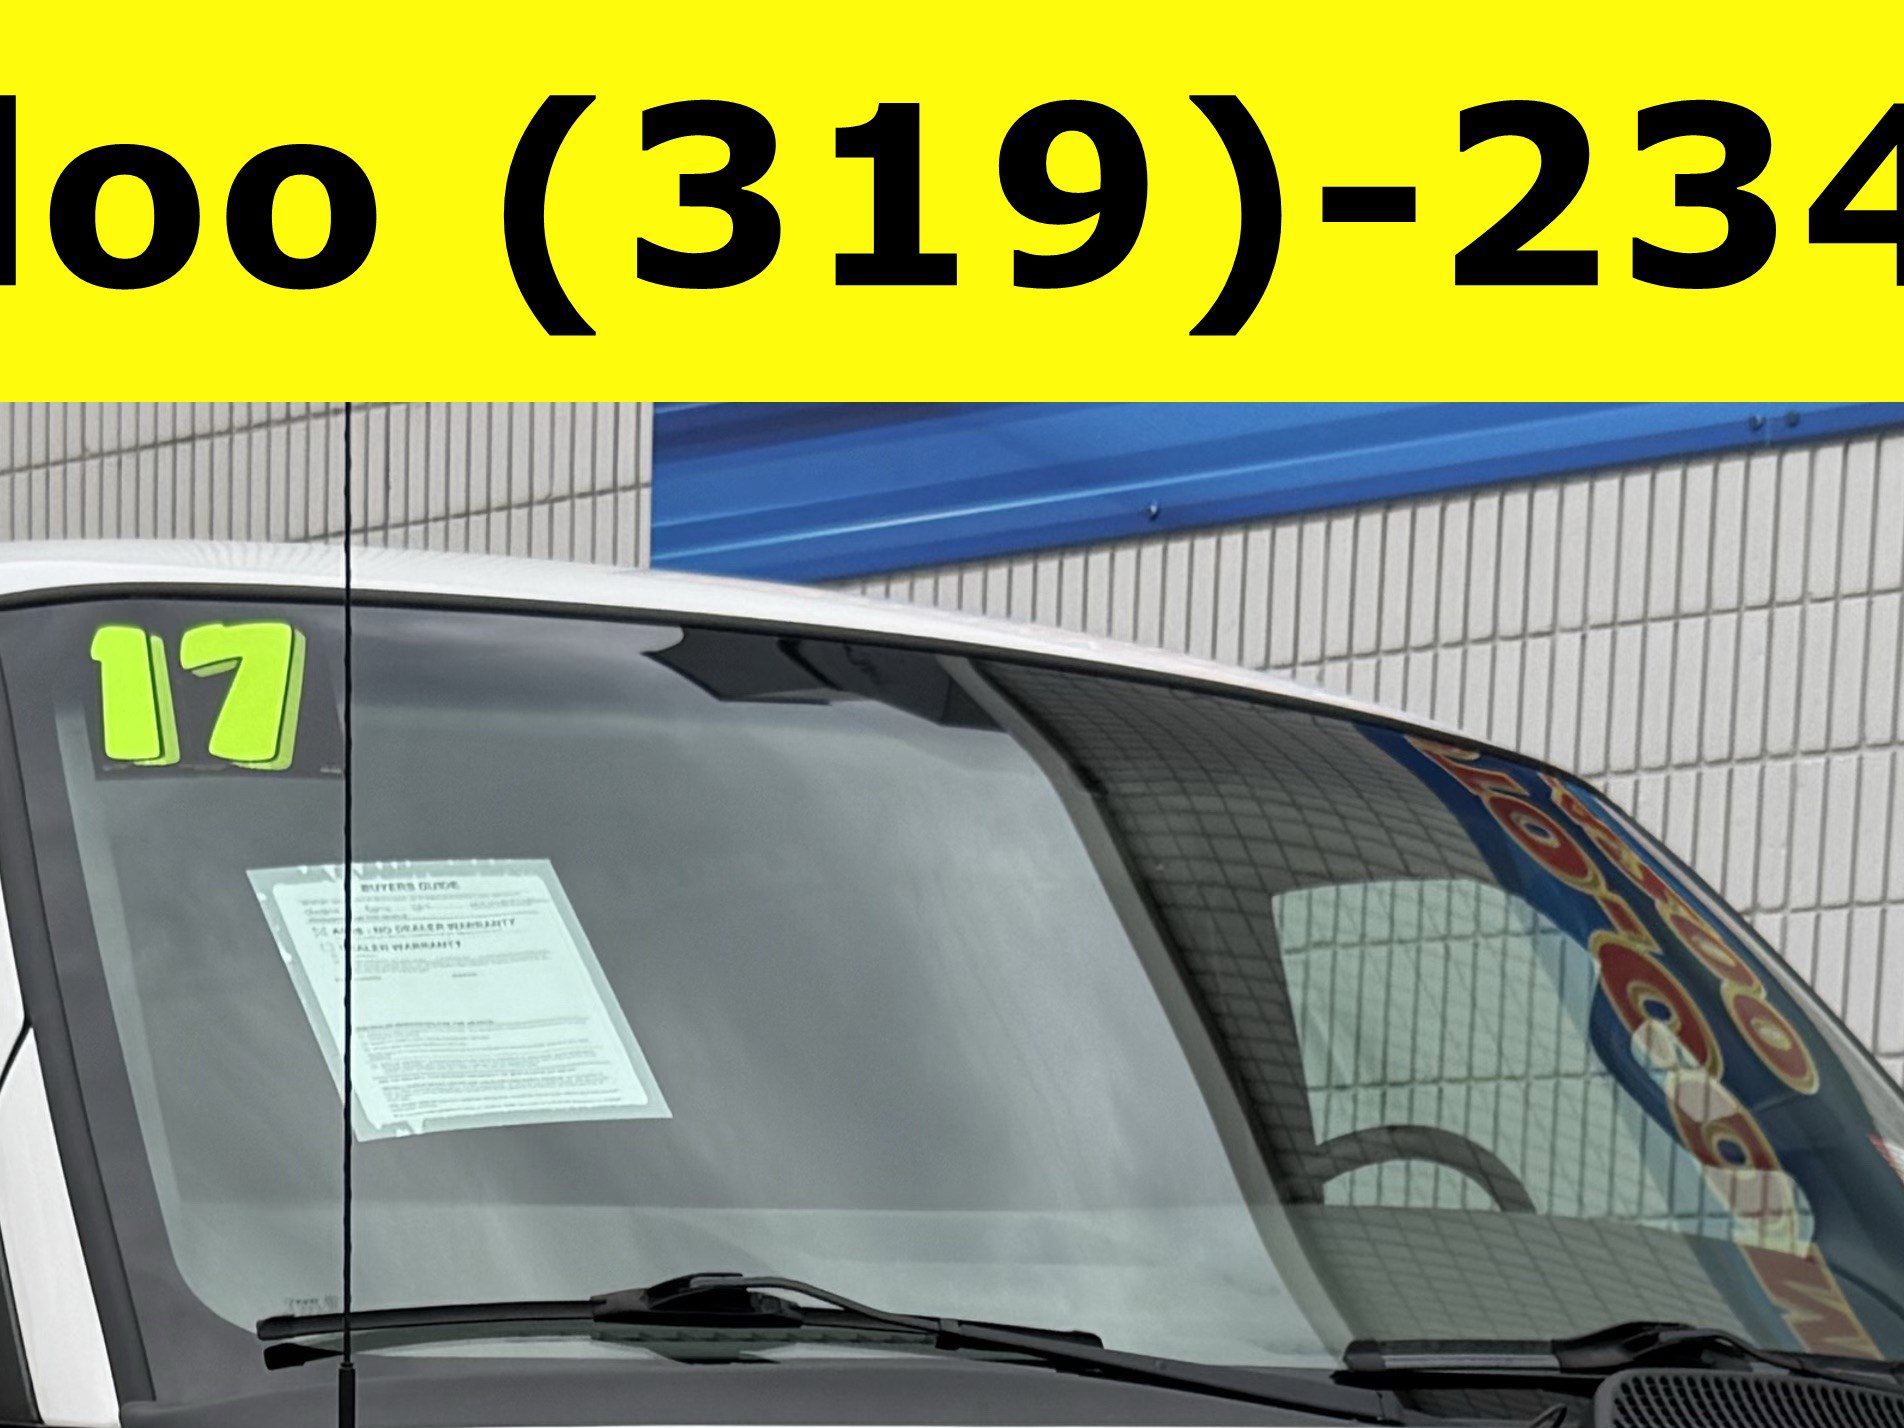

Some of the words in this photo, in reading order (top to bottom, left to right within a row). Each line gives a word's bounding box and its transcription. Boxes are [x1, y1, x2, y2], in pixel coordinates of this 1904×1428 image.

[91, 622, 305, 770] 17
[361, 882, 415, 892] BUYERS
[418, 881, 459, 891] GUIDE
[447, 918, 516, 931] WARRANTY
